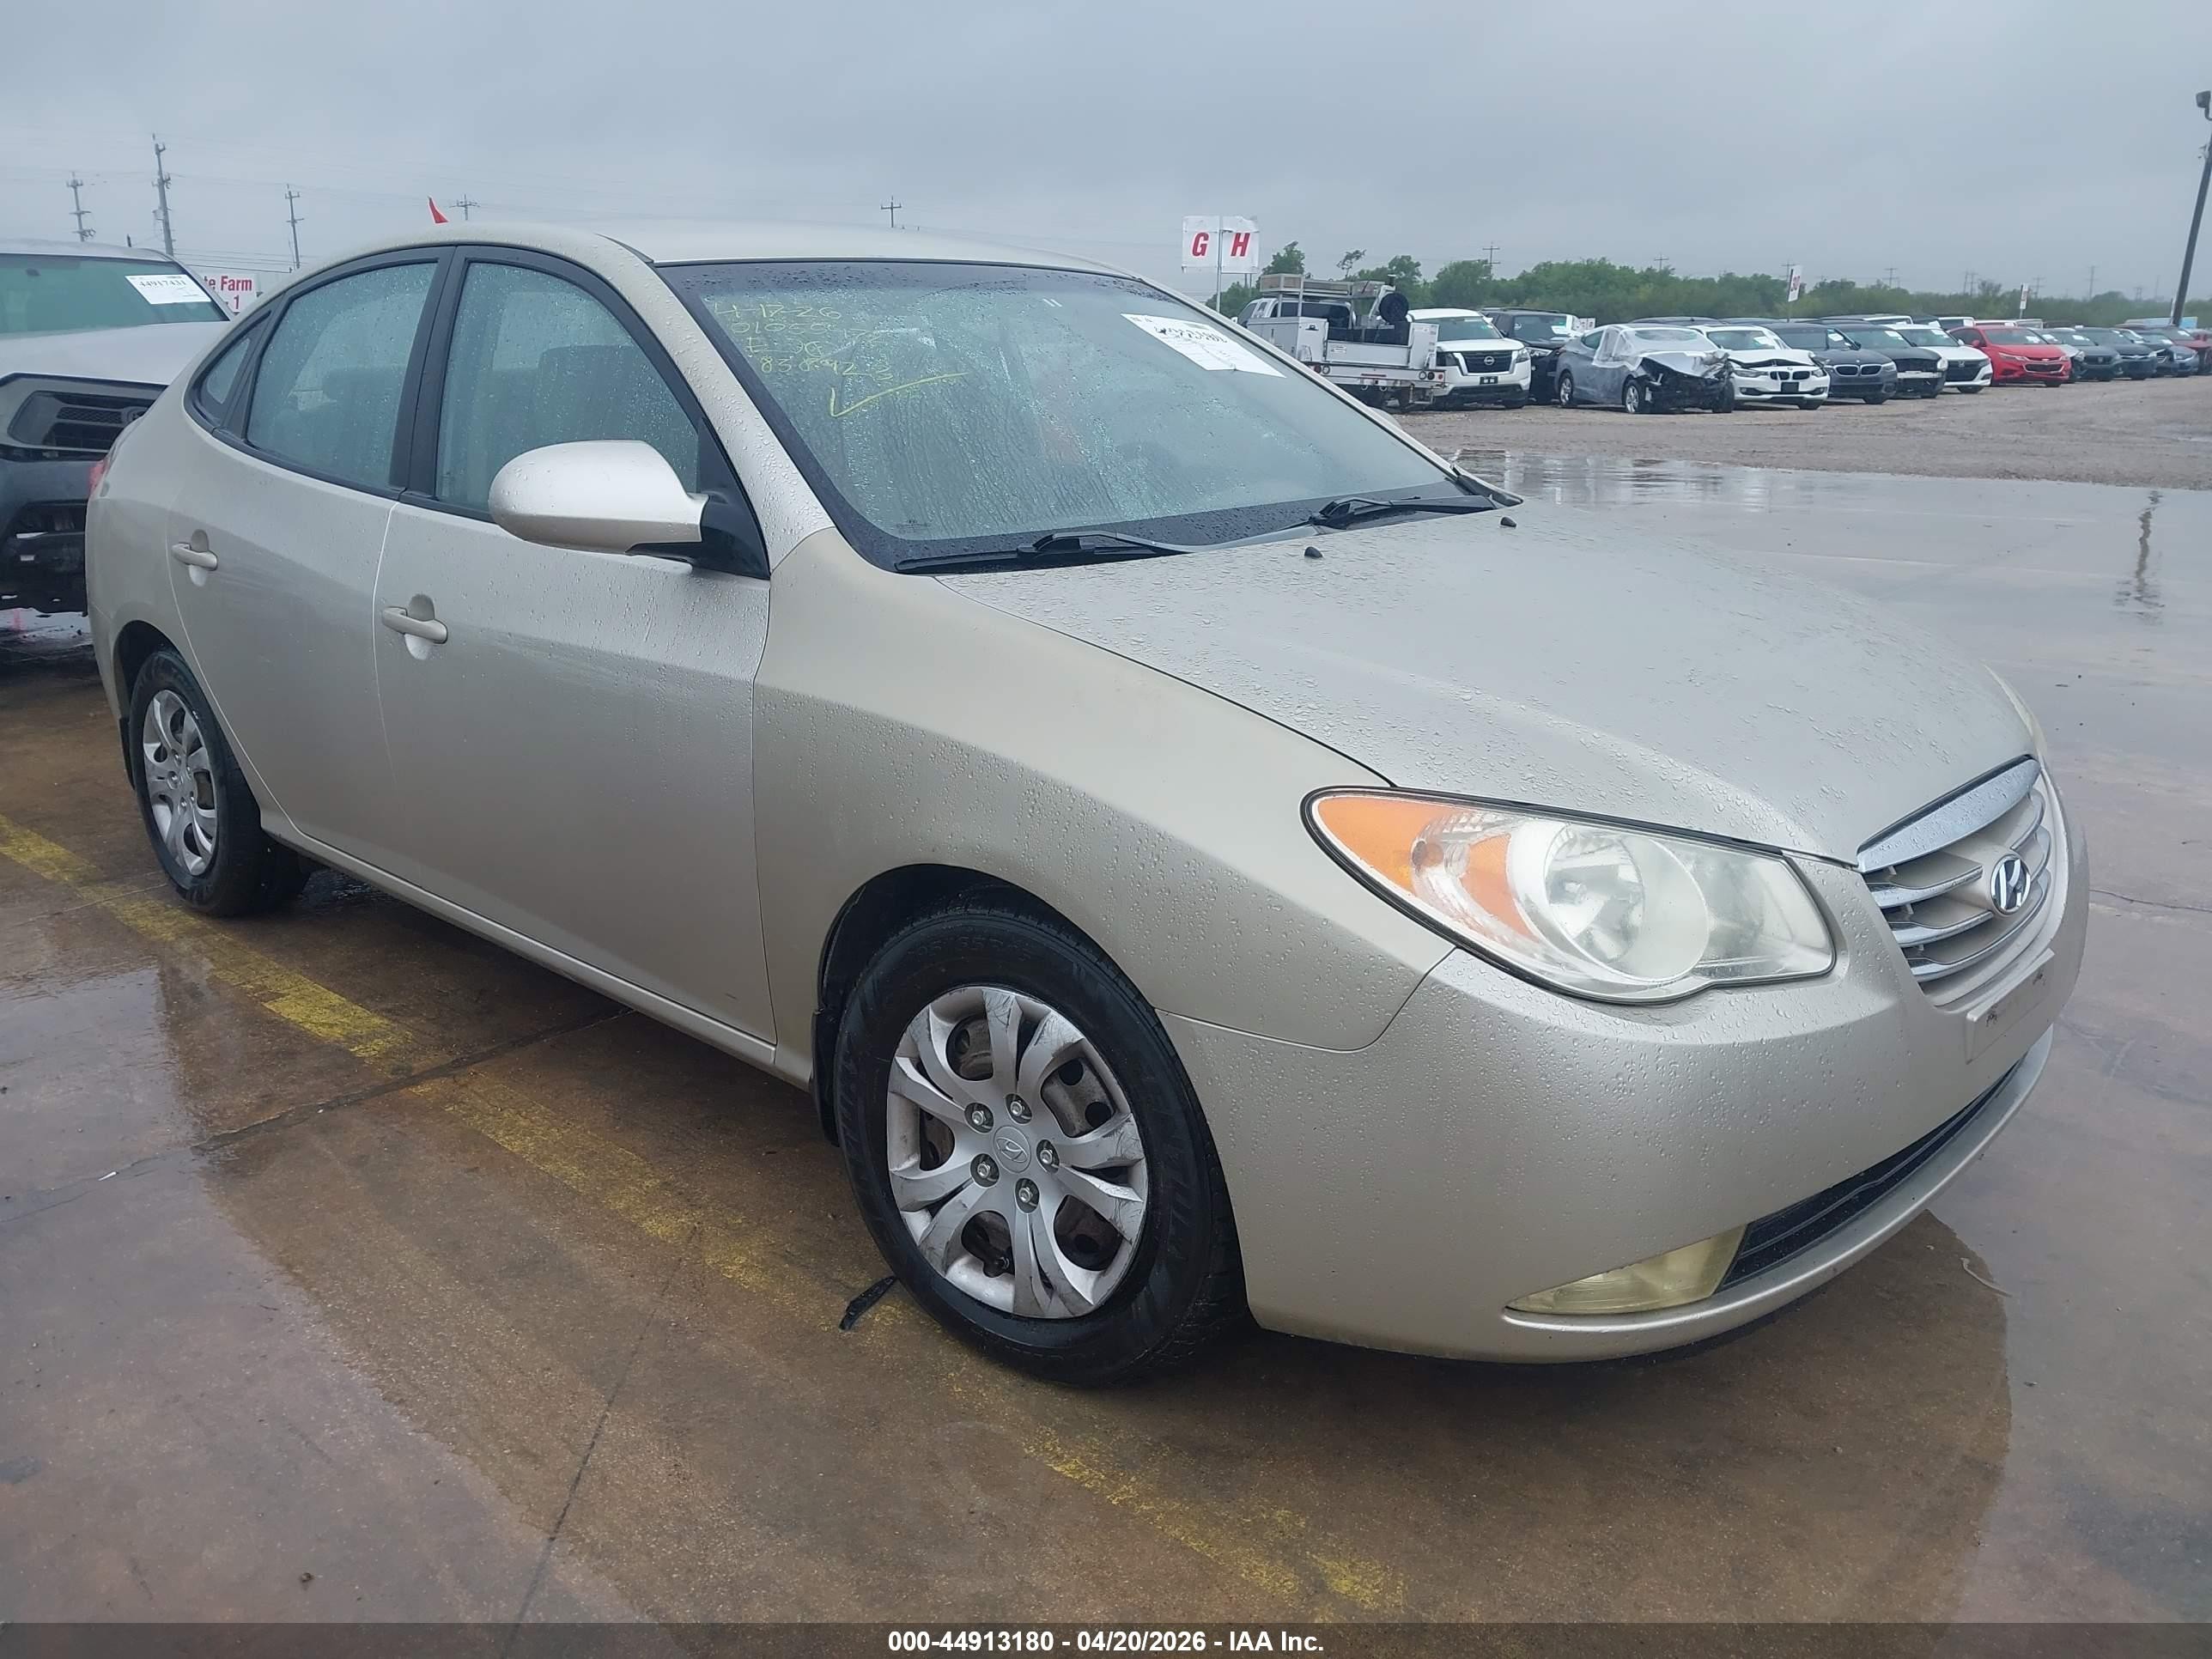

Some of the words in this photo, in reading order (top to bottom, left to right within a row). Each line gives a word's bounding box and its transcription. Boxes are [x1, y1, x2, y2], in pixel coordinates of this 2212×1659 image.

[1192, 232, 1209, 257] G
[1230, 232, 1251, 257] H
[221, 275, 252, 291] Farm
